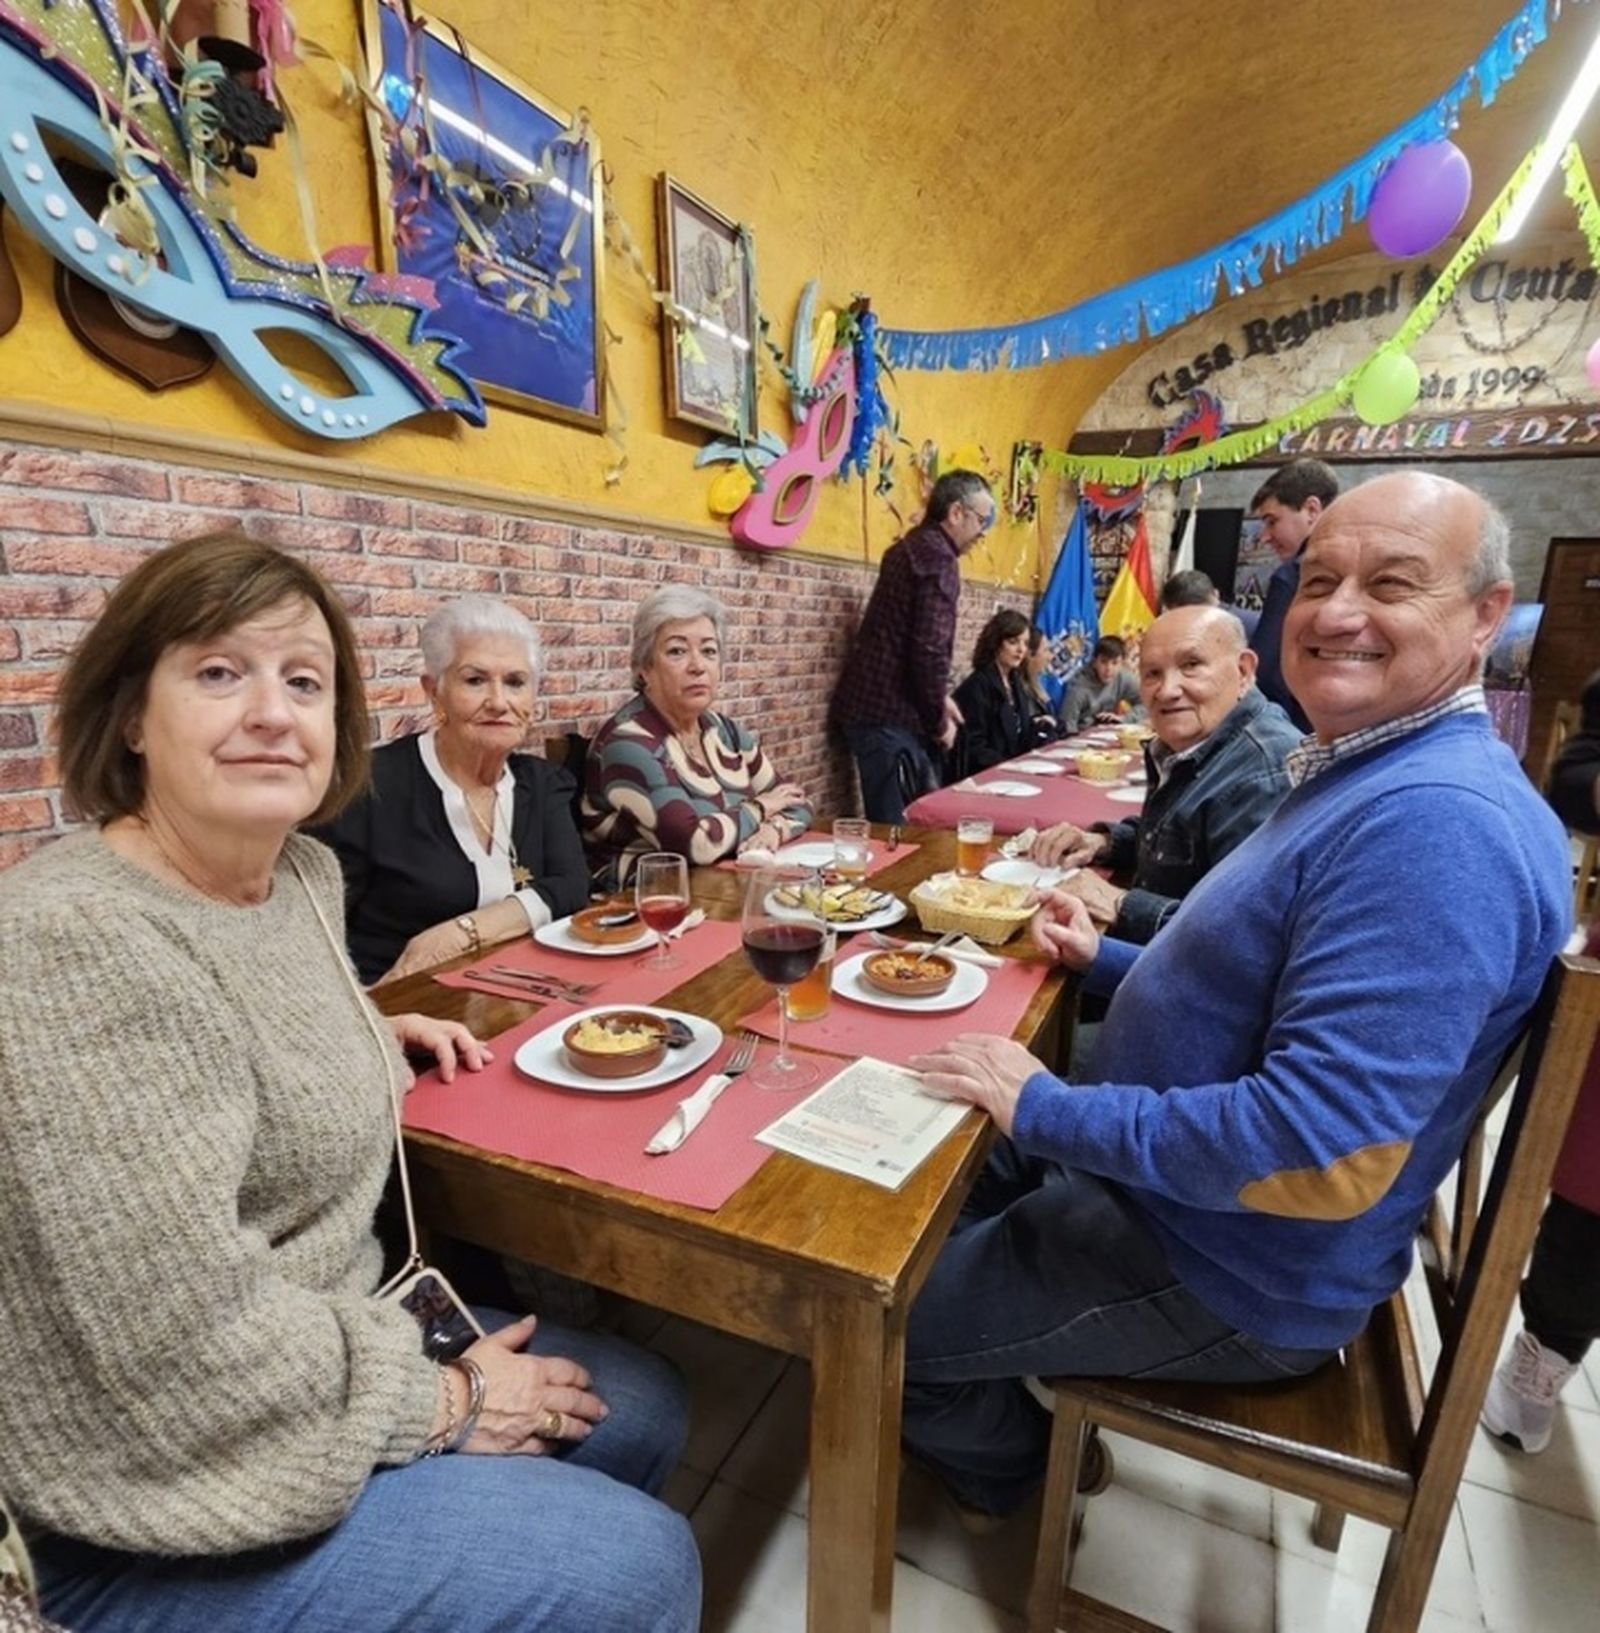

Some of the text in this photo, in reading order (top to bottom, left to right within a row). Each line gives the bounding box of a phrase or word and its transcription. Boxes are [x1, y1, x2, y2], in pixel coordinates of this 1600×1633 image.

[1148, 342, 1234, 408] Casa
[1242, 270, 1404, 361] Regional
[1470, 257, 1598, 303] Ceuta
[1463, 365, 1546, 398] 1999
[1279, 412, 1600, 454] CARNAVAL 2025
